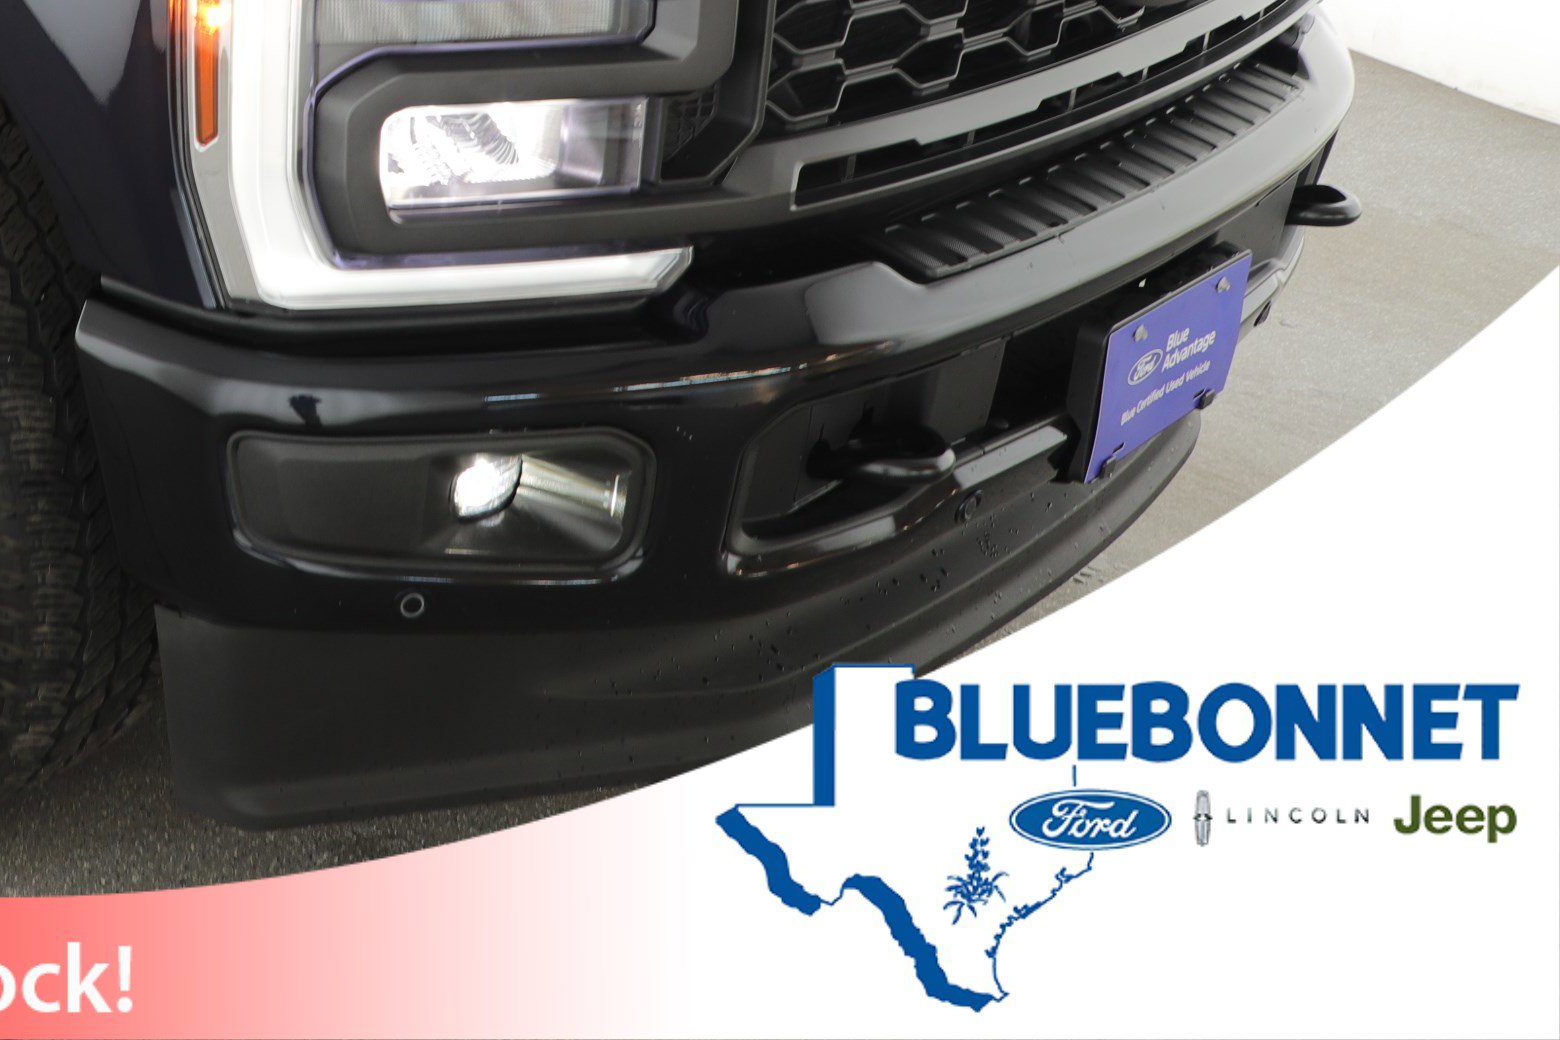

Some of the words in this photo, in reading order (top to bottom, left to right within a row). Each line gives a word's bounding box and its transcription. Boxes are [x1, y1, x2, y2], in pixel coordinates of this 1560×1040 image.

[1161, 330, 1216, 373] Advantage
[1165, 327, 1190, 352] Blue
[1121, 406, 1137, 426] Blue
[1165, 372, 1186, 394] Used
[1185, 360, 1211, 382] Vehicle
